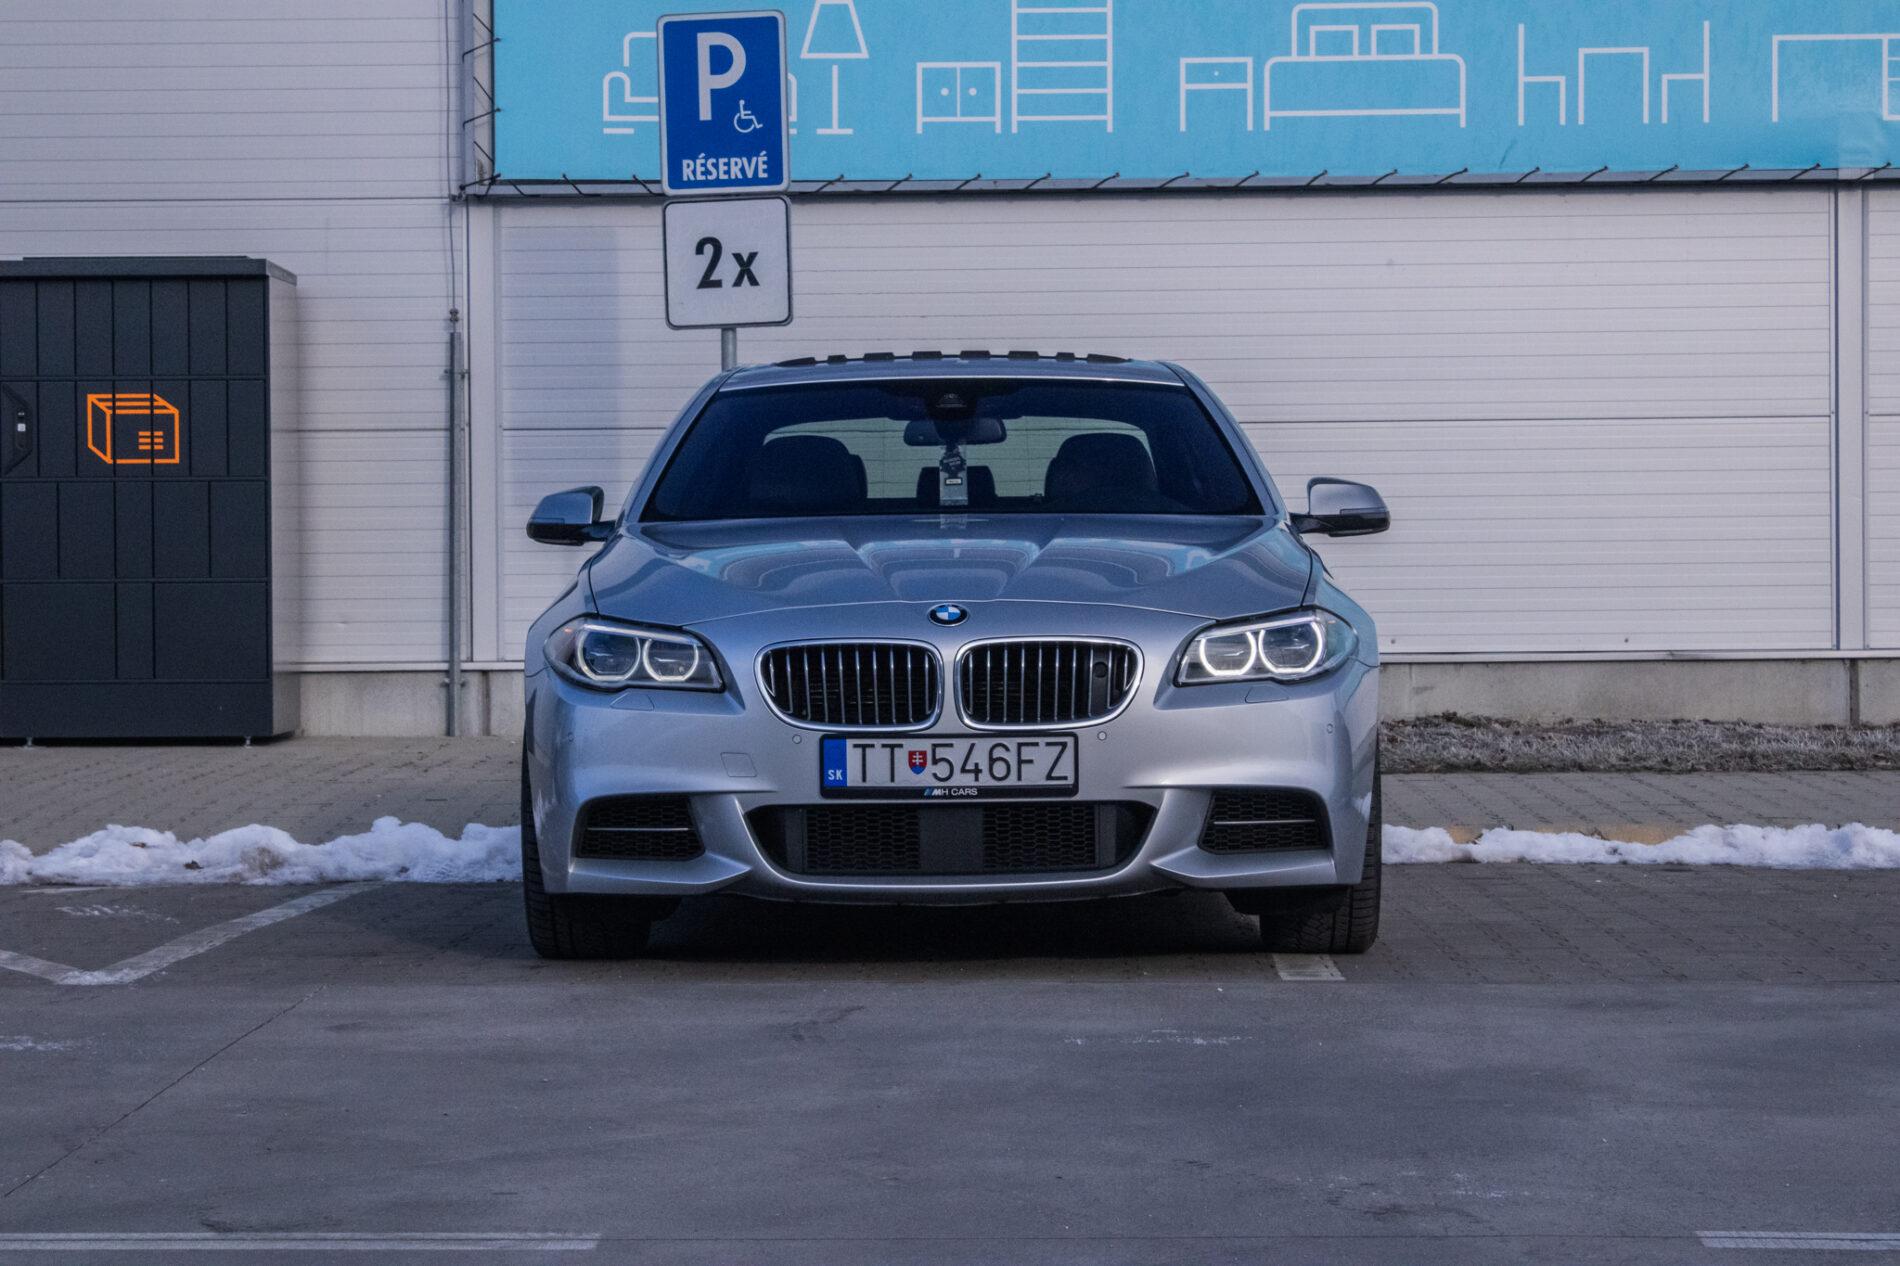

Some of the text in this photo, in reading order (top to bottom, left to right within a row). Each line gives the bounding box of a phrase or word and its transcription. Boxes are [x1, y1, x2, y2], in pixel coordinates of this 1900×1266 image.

[697, 32, 747, 121] P
[682, 152, 769, 182] RÉSERVÉ
[828, 770, 843, 781] SK
[853, 741, 1068, 783] TT 546FZ
[951, 788, 978, 796] CARS
